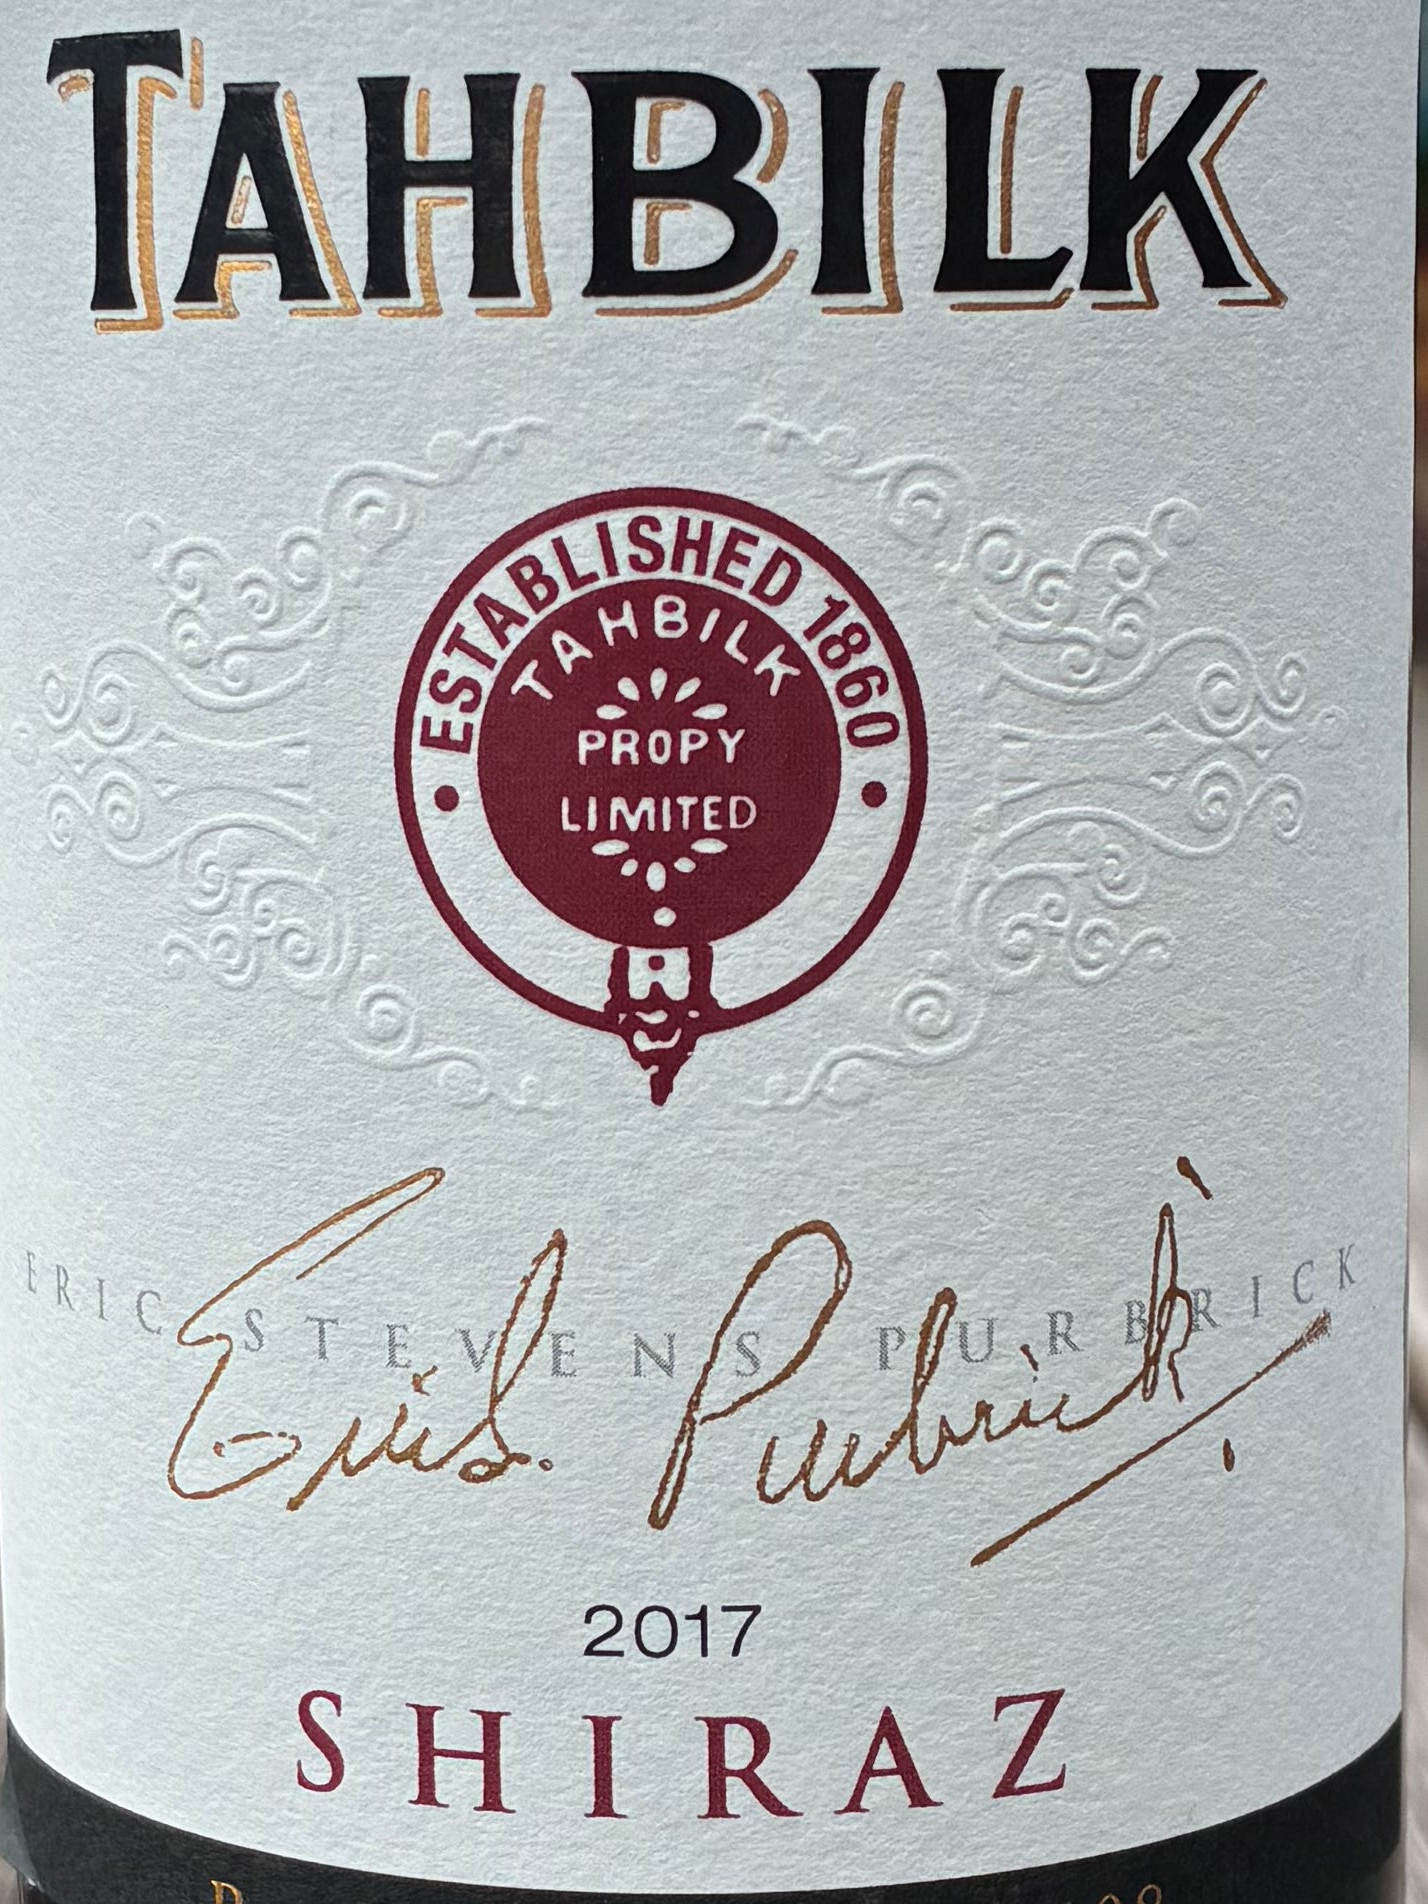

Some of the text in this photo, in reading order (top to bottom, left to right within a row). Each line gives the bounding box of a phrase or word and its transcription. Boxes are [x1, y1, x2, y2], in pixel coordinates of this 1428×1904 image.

[45, 28, 1288, 332] TAHBILK
[417, 513, 901, 756] ESTABLISHED 1860
[510, 595, 802, 701] TAHBILK
[576, 728, 746, 766] PROPY
[560, 796, 757, 833] LIMITED
[24, 1243, 1359, 1381] ERIC STEVENS PURBRICK
[583, 1603, 763, 1659] 2017
[294, 1687, 1068, 1821] SHIRAZ
